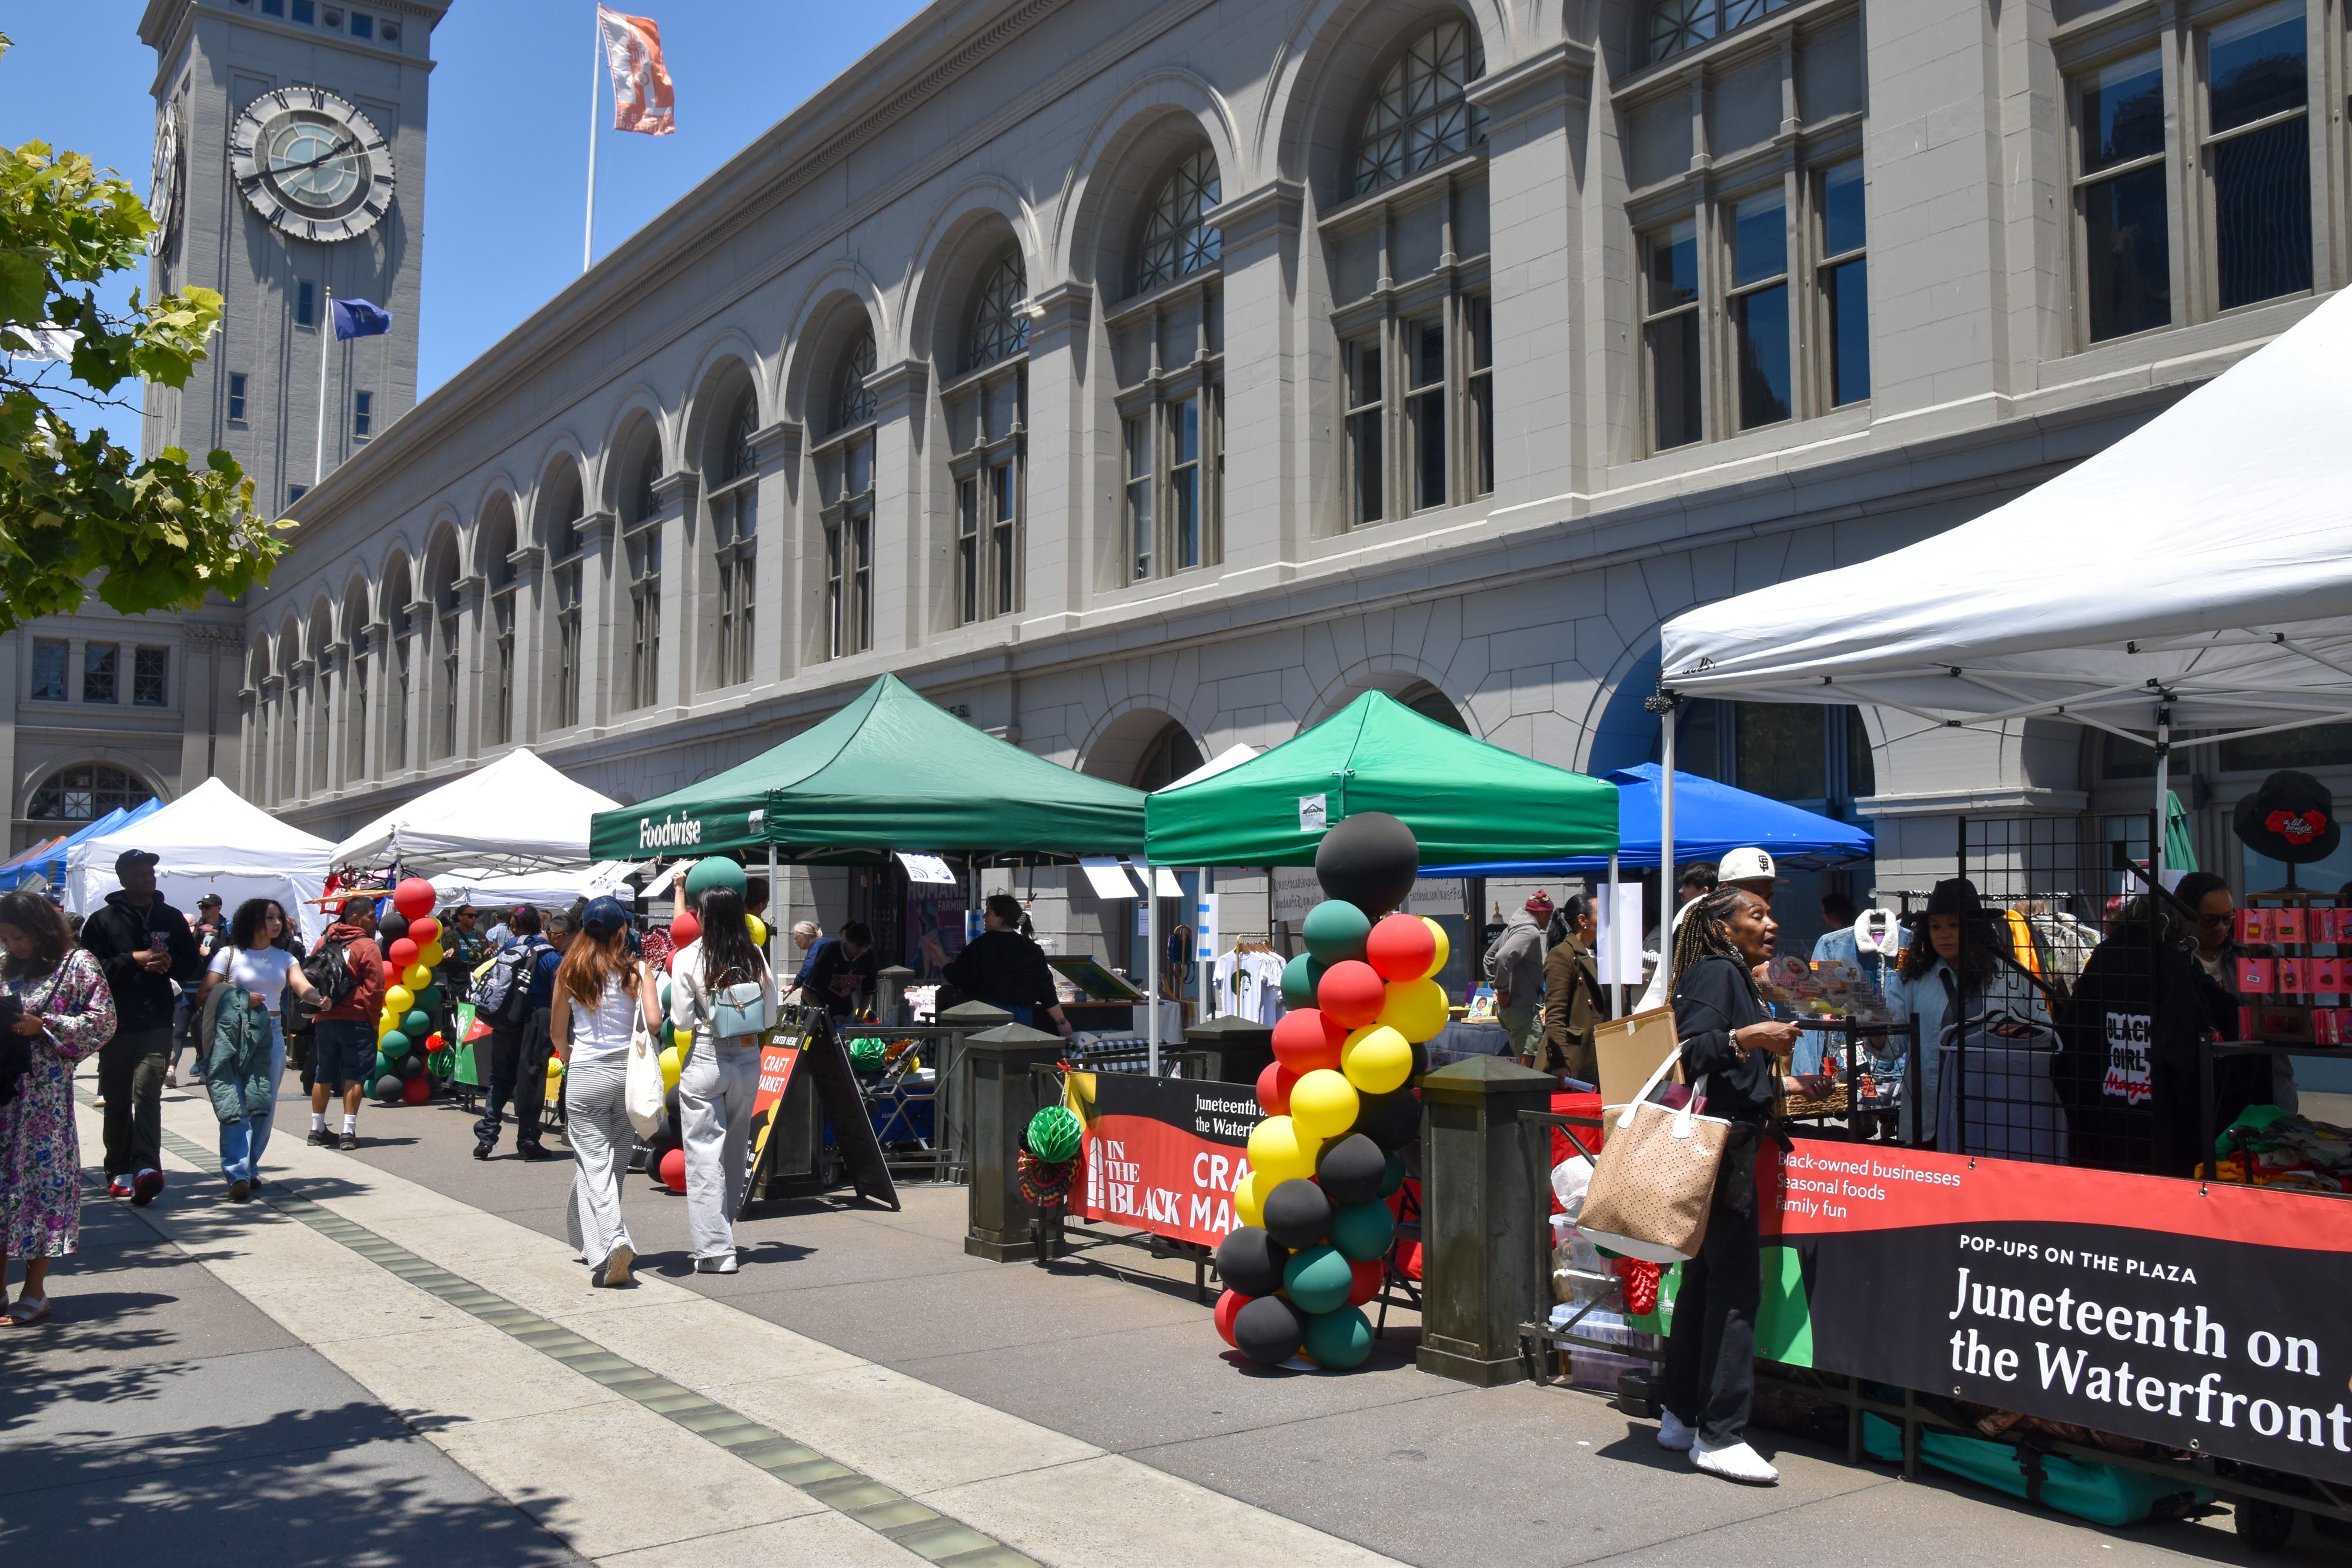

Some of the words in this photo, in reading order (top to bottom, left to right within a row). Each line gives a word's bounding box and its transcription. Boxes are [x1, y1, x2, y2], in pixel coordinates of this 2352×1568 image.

[619, 111, 670, 125] FERRY
[639, 810, 700, 849] Foodwise
[907, 875, 968, 899] HUMANE
[937, 900, 968, 912] FARMING
[772, 1035, 786, 1045] ENTER
[786, 1037, 799, 1046] HERE
[763, 1055, 790, 1073] CRAFT
[2113, 1048, 2147, 1072] GIRL
[2106, 1071, 2153, 1099] Magi
[1195, 1094, 1257, 1116] Juneteenth
[1195, 1116, 1210, 1133] the
[1212, 1118, 1254, 1138] Waterf
[1106, 1140, 1125, 1161] IN
[1105, 1161, 1140, 1183] THE
[1193, 1152, 1248, 1193] CRA
[1778, 1151, 1869, 1176] Black-owned
[1873, 1160, 1961, 1186] businesses
[1777, 1173, 1839, 1195] Seasonal
[1842, 1179, 1886, 1201] foods
[1108, 1181, 1182, 1226] BLACK
[1775, 1195, 1819, 1218] Family
[1822, 1199, 1847, 1218] fun
[1959, 1234, 2039, 1260] POP-UPS
[2044, 1246, 2074, 1265] ON
[2080, 1252, 2119, 1272] THE
[2126, 1259, 2197, 1285] PLAZA
[1949, 1267, 2227, 1359] Juneteenth
[2247, 1330, 2321, 1377] on
[1950, 1328, 2019, 1382] the
[2034, 1341, 2352, 1453] Waterfront
